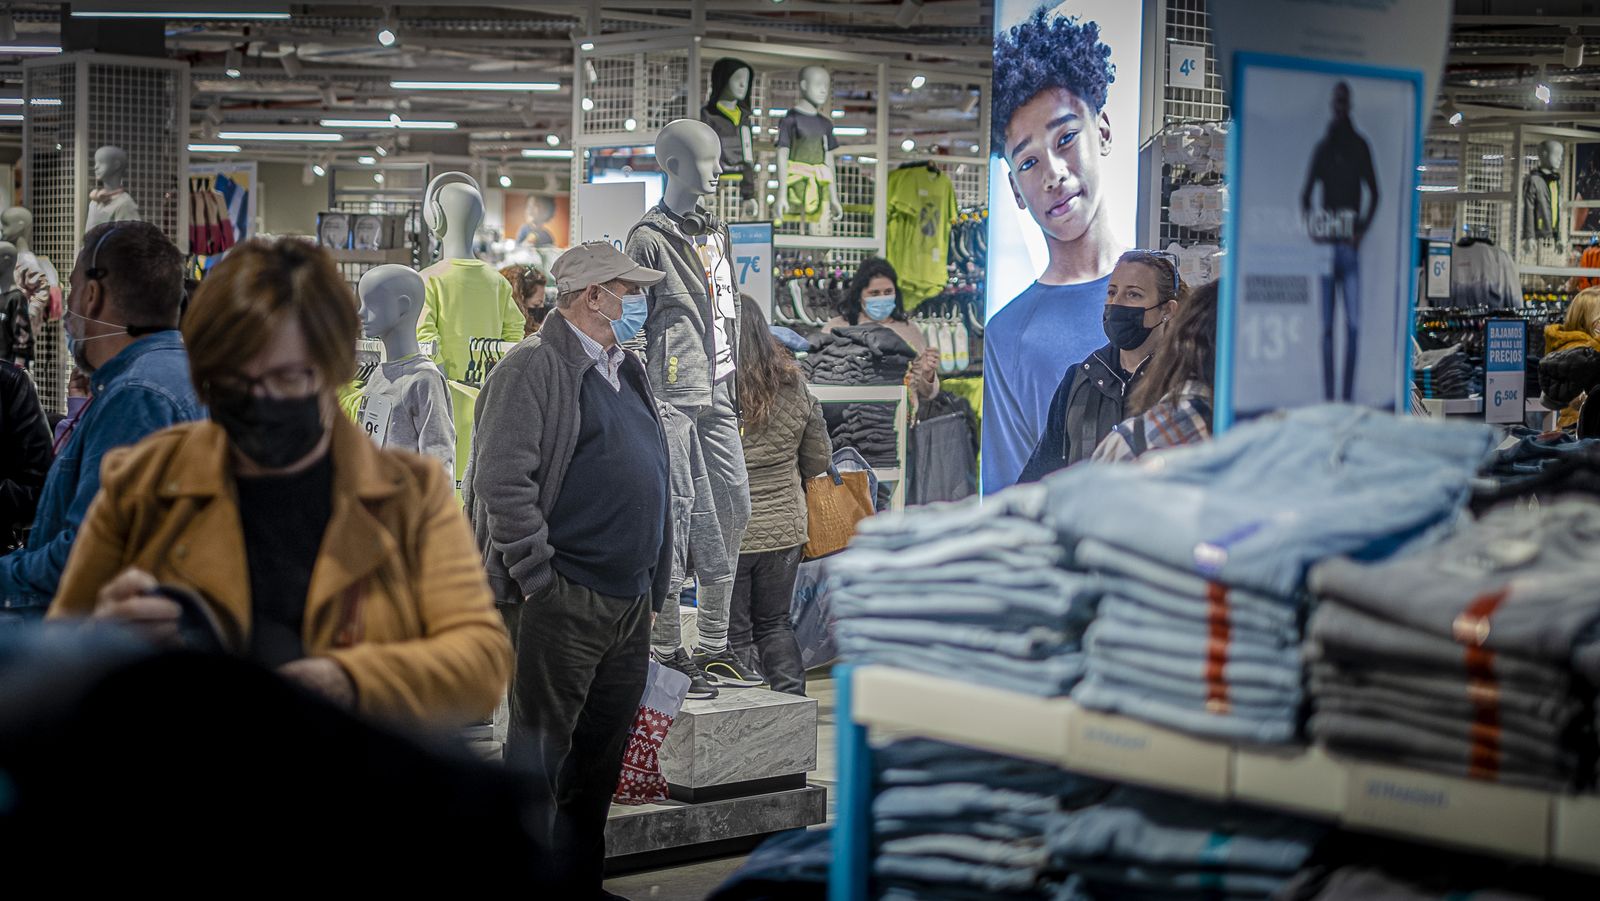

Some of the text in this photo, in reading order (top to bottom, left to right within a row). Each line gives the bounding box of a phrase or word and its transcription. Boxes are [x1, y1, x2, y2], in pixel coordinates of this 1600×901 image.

[736, 255, 761, 285] 7€
[1490, 327, 1523, 338] BAJAMOS
[1490, 350, 1523, 363] PRECIOS
